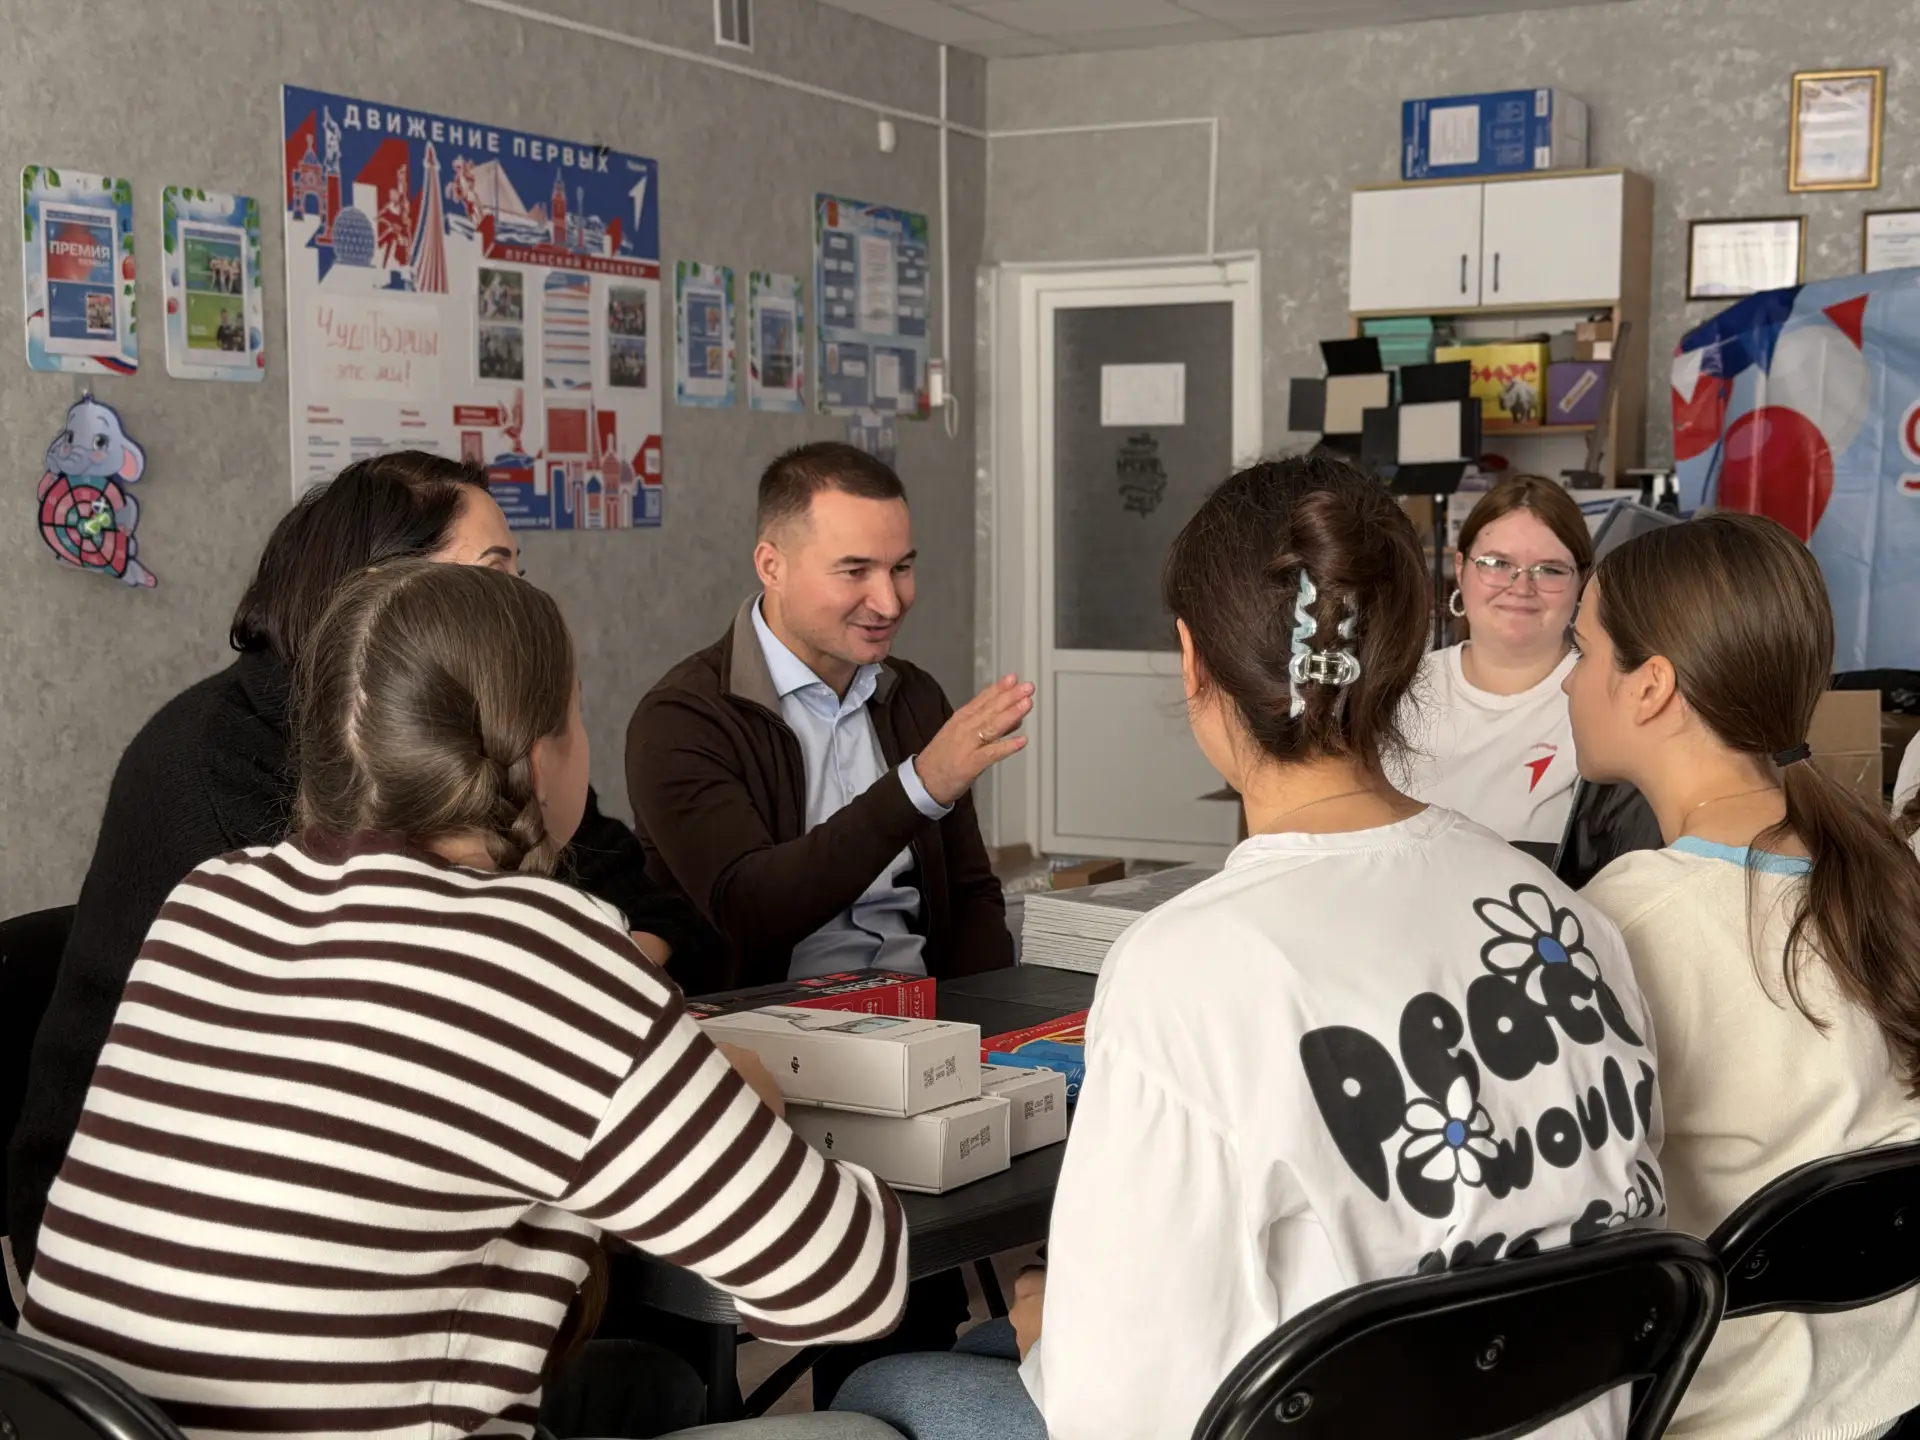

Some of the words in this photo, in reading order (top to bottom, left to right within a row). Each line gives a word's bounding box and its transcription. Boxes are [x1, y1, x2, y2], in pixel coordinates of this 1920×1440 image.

[343, 104, 501, 153] ДВИЖЕНИЕ
[513, 136, 609, 173] ПЕРВЫХ
[49, 240, 110, 259] ПРЕМИЯ
